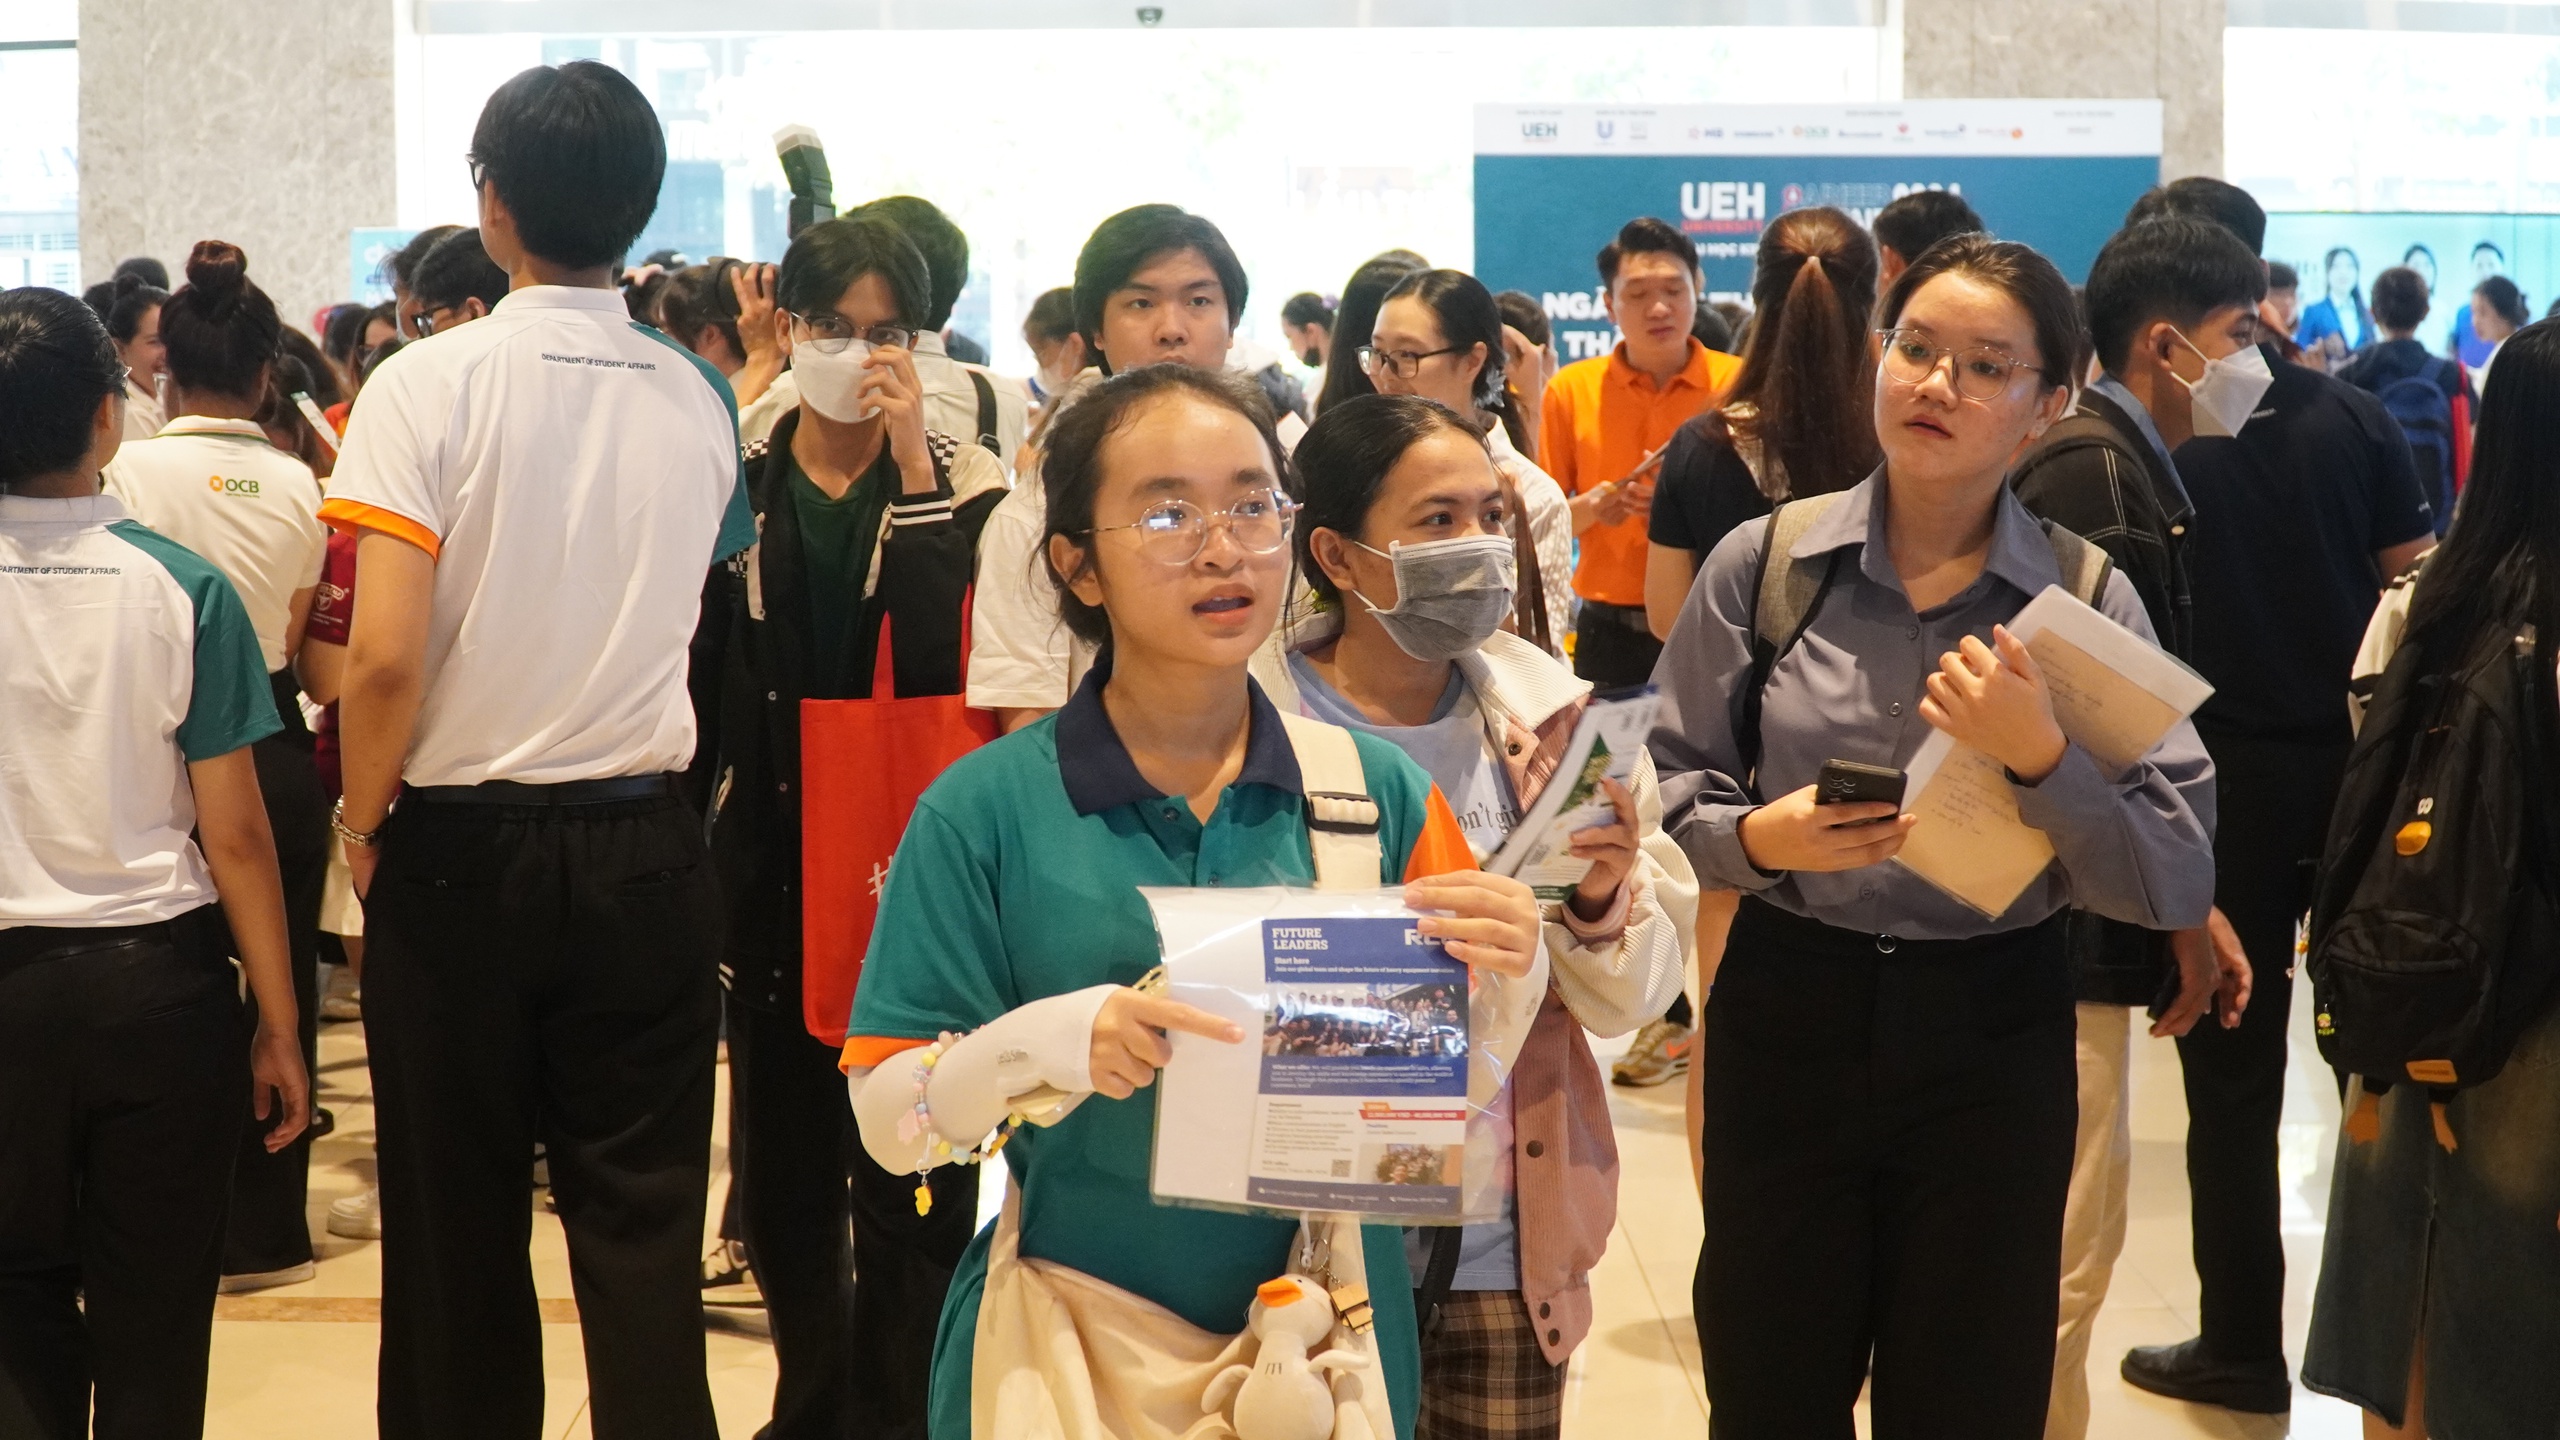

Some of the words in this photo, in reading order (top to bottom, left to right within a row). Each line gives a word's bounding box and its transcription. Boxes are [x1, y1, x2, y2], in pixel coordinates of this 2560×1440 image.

[1680, 181, 1765, 221] UEH
[541, 353, 585, 364] DEPARTMENT
[594, 359, 626, 368] STUDENT
[627, 362, 656, 370] AFFAIRS
[225, 478, 259, 493] OCB
[40, 567, 51, 575] OF
[53, 567, 89, 575] STUDENT
[90, 567, 121, 575] AFFAIRS
[1272, 927, 1322, 938] FUTURE
[1273, 939, 1329, 950] LEADERS
[1274, 956, 1292, 965] Start
[1293, 956, 1310, 965] here
